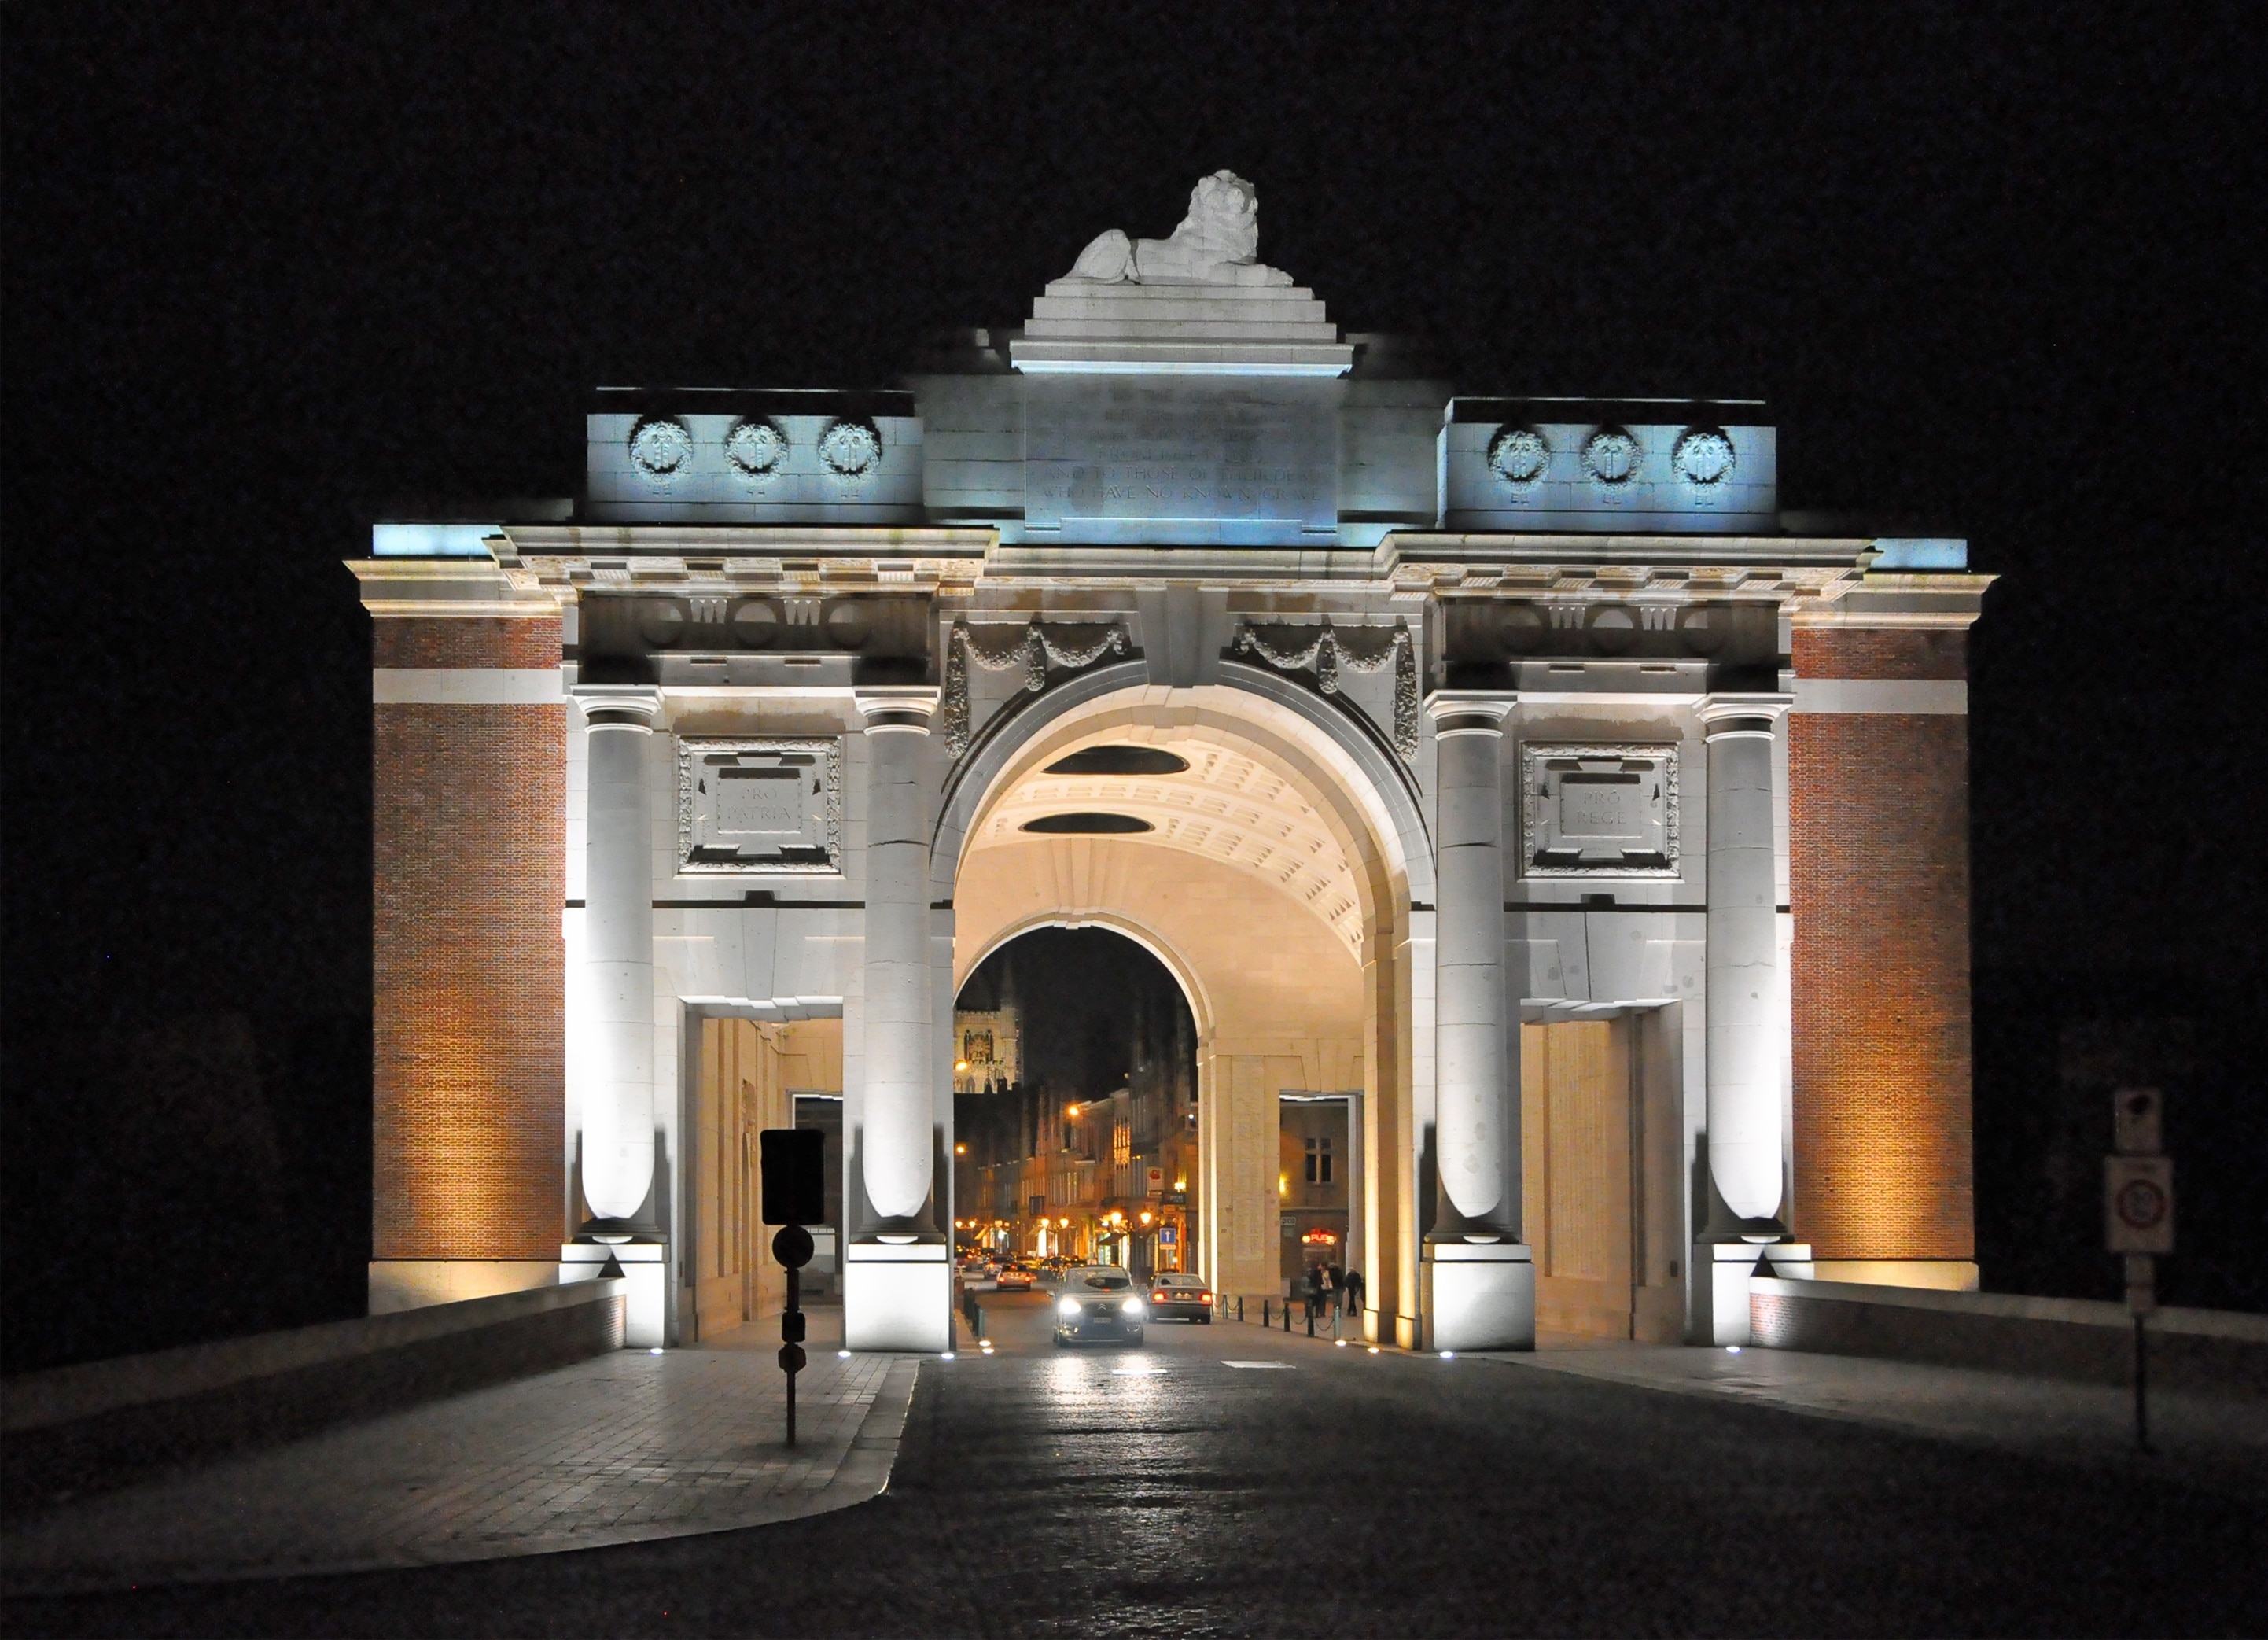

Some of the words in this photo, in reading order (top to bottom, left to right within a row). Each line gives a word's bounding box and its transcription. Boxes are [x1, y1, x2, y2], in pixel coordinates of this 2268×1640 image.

[1047, 465, 1084, 480] AND
[1090, 466, 1116, 480] TO
[1125, 466, 1179, 480] THOSE
[1188, 467, 1207, 481] OF
[1042, 485, 1084, 499] WHO
[1092, 485, 1136, 499] HAVE
[1146, 485, 1173, 499] NO
[1183, 486, 1251, 500] KNOWN
[1262, 487, 1323, 501] GRAVE
[742, 786, 778, 799] PRO
[1582, 789, 1621, 805] PRO
[727, 805, 792, 821] PATRIA
[1576, 810, 1627, 825] REGE
